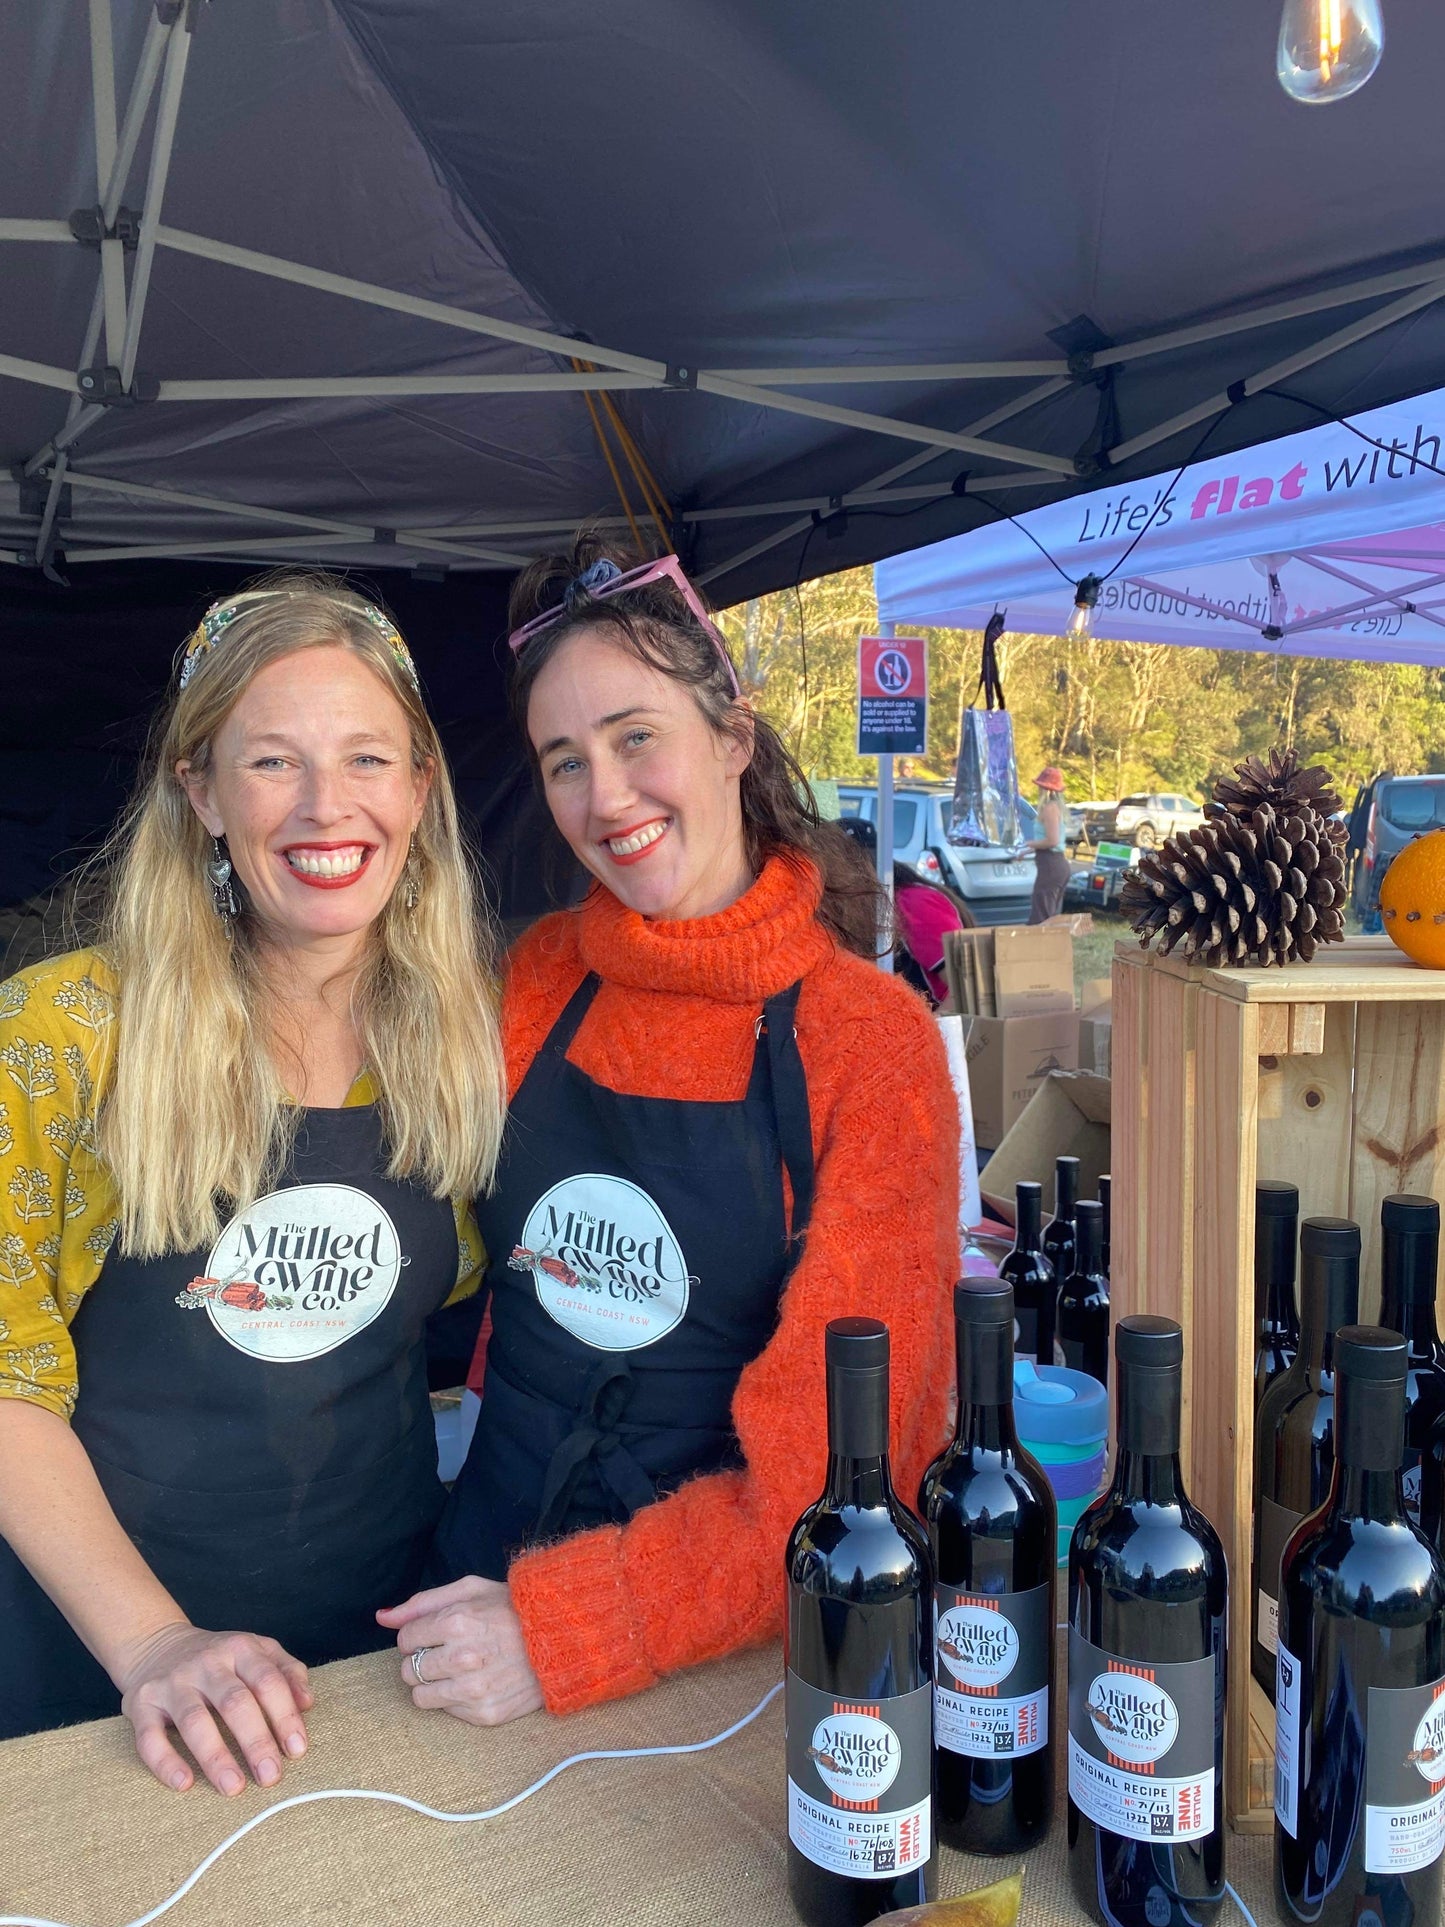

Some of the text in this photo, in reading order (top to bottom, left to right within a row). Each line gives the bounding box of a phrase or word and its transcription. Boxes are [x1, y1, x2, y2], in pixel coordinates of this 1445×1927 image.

[1078, 424, 1441, 543] Life's flat with
[873, 700, 895, 708] alcohol
[884, 709, 909, 717] supplied
[872, 725, 893, 733] against
[284, 1222, 307, 1234] The
[578, 1210, 597, 1225] The
[235, 1221, 388, 1267] Mulled
[541, 1204, 672, 1282] Mulled
[254, 1260, 373, 1302] Wine
[558, 1245, 661, 1298] Wine
[241, 1320, 285, 1329] CENTRAL
[289, 1320, 321, 1328] COAST
[556, 1297, 650, 1327] CENTRAL COAST NSW
[946, 1618, 1014, 1646] Mulled
[955, 1637, 1007, 1662] Wine
[1097, 1684, 1171, 1721] Mulled
[1115, 1689, 1127, 1697] The
[970, 1706, 1009, 1717] RECIPE
[1017, 1705, 1028, 1747] WINE
[1030, 1701, 1038, 1743] MULLED
[1107, 1705, 1165, 1738] Wine
[821, 1727, 895, 1755] Mulled
[841, 1730, 851, 1738] The
[832, 1747, 888, 1773] Wine
[1075, 1753, 1168, 1798] ORIGINAL RECIPE
[797, 1797, 890, 1834] ORIGINAL RECIPE
[1178, 1786, 1191, 1832] WINE
[1193, 1784, 1202, 1829] MULLED
[1390, 1808, 1437, 1827] ORIGINAL
[899, 1818, 911, 1864] WINE
[912, 1814, 920, 1859] MULLED
